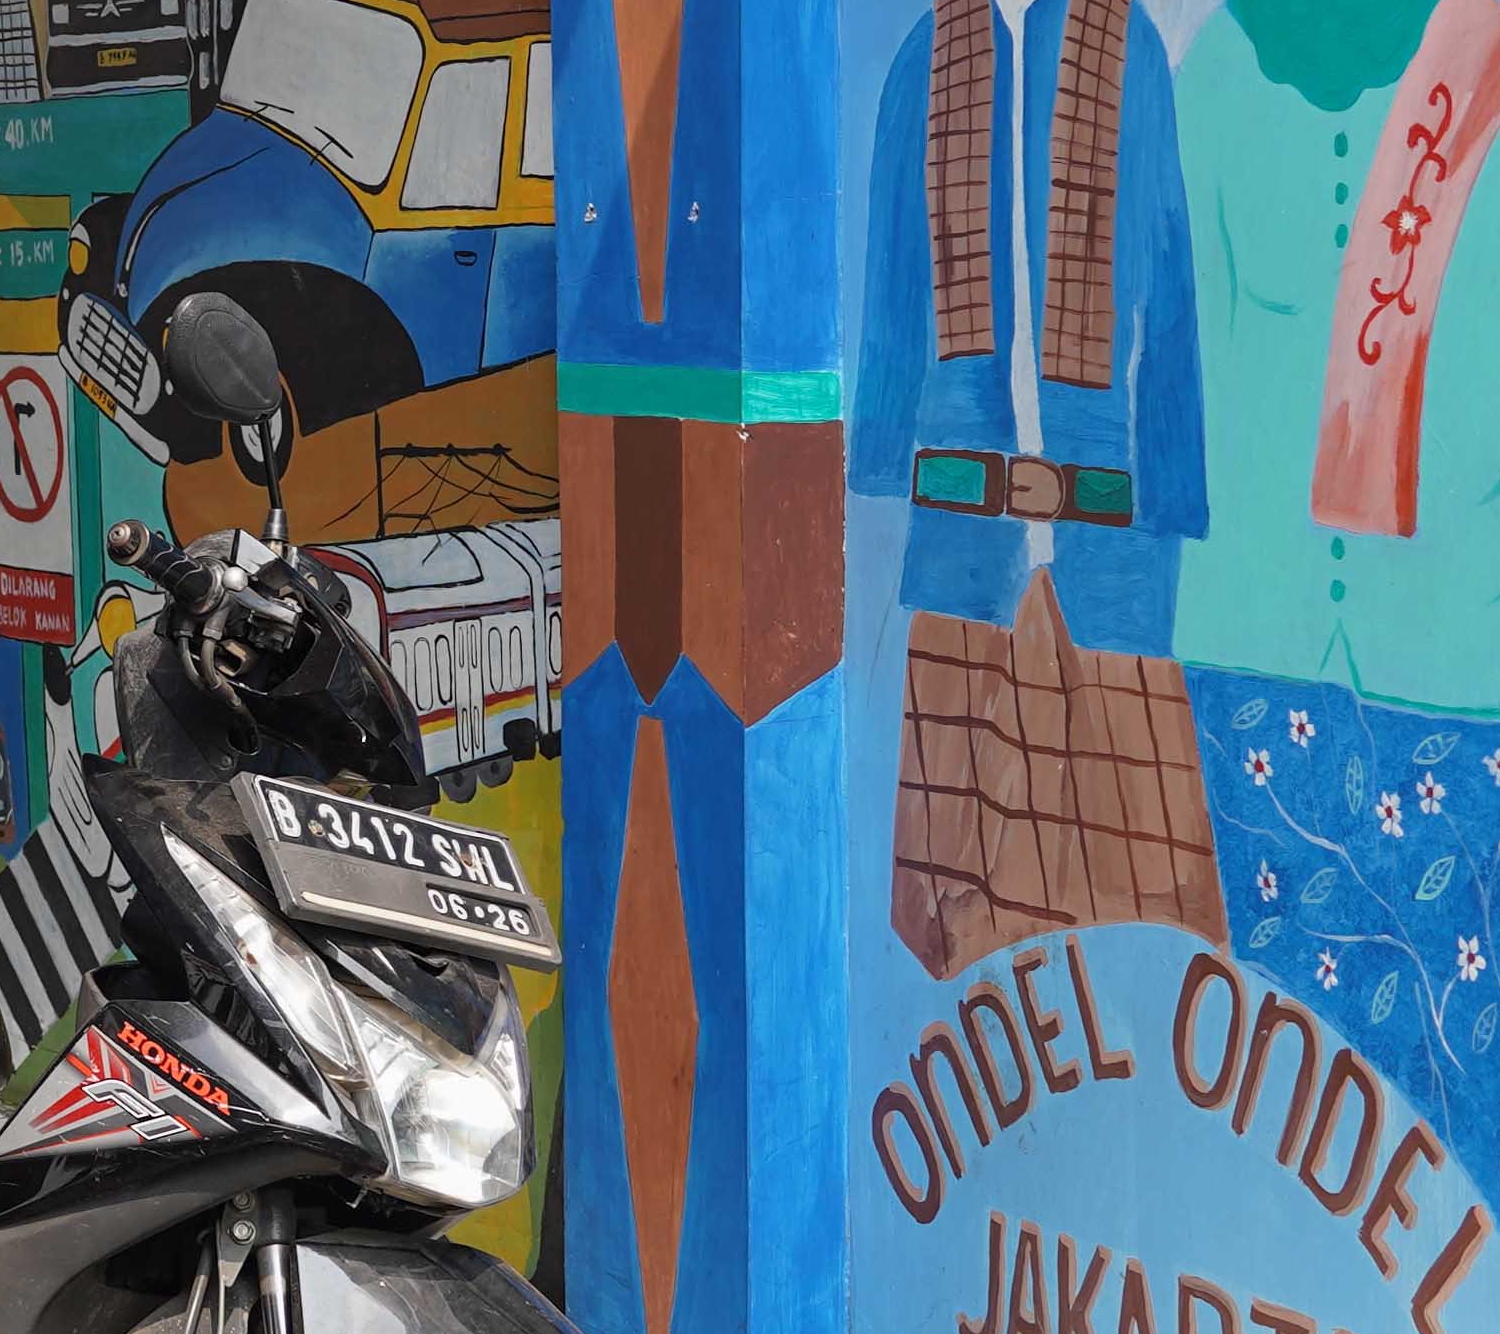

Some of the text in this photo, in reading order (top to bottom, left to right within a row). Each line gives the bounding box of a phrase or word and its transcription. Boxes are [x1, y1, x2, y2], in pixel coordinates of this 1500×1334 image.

[1, 571, 56, 601] DILARANG
[35, 611, 70, 632] KANAN
[266, 789, 301, 838] B
[318, 804, 425, 867] 3412
[117, 1021, 230, 1116] HONDA
